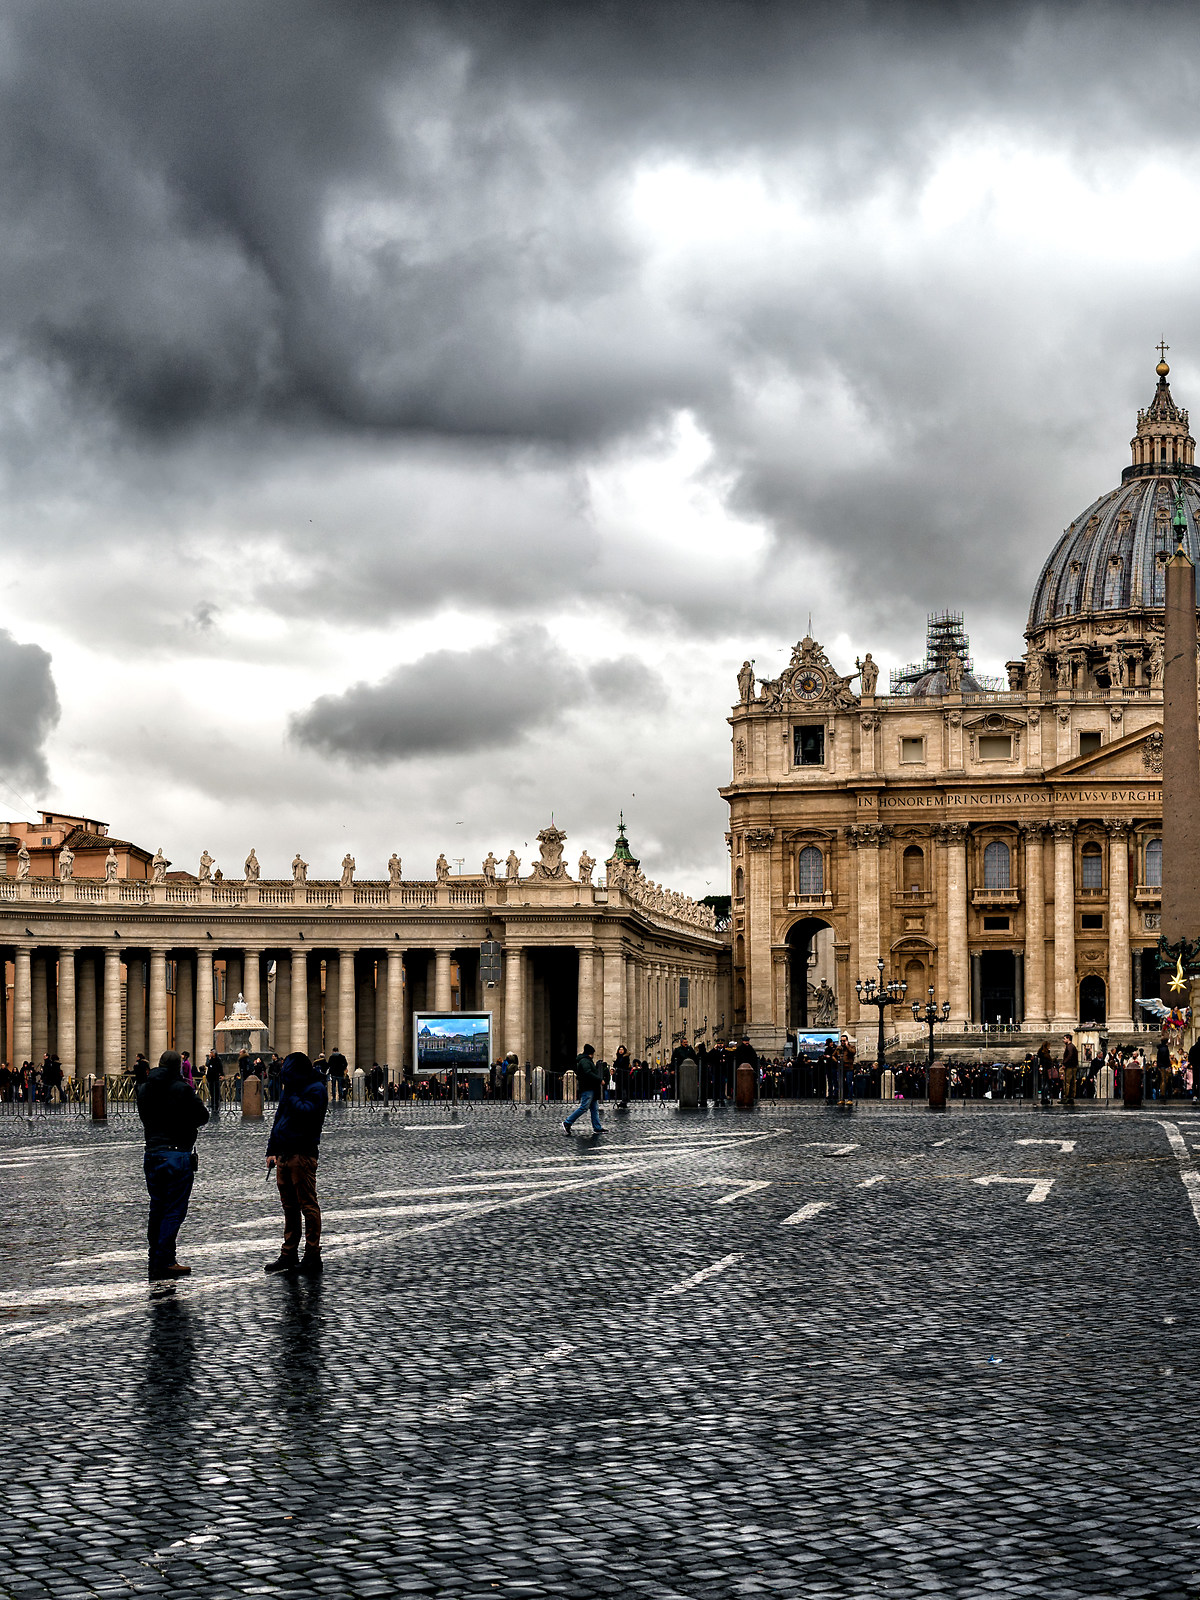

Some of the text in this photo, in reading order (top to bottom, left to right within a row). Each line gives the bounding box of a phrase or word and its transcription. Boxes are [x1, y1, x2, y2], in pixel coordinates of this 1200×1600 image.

[858, 797, 873, 807] IN
[879, 796, 944, 807] HONOREM
[947, 794, 1012, 805] PRINCIPIS
[1014, 793, 1053, 803] APOST
[1055, 791, 1098, 801] PAVLVS
[1100, 791, 1110, 801] V
